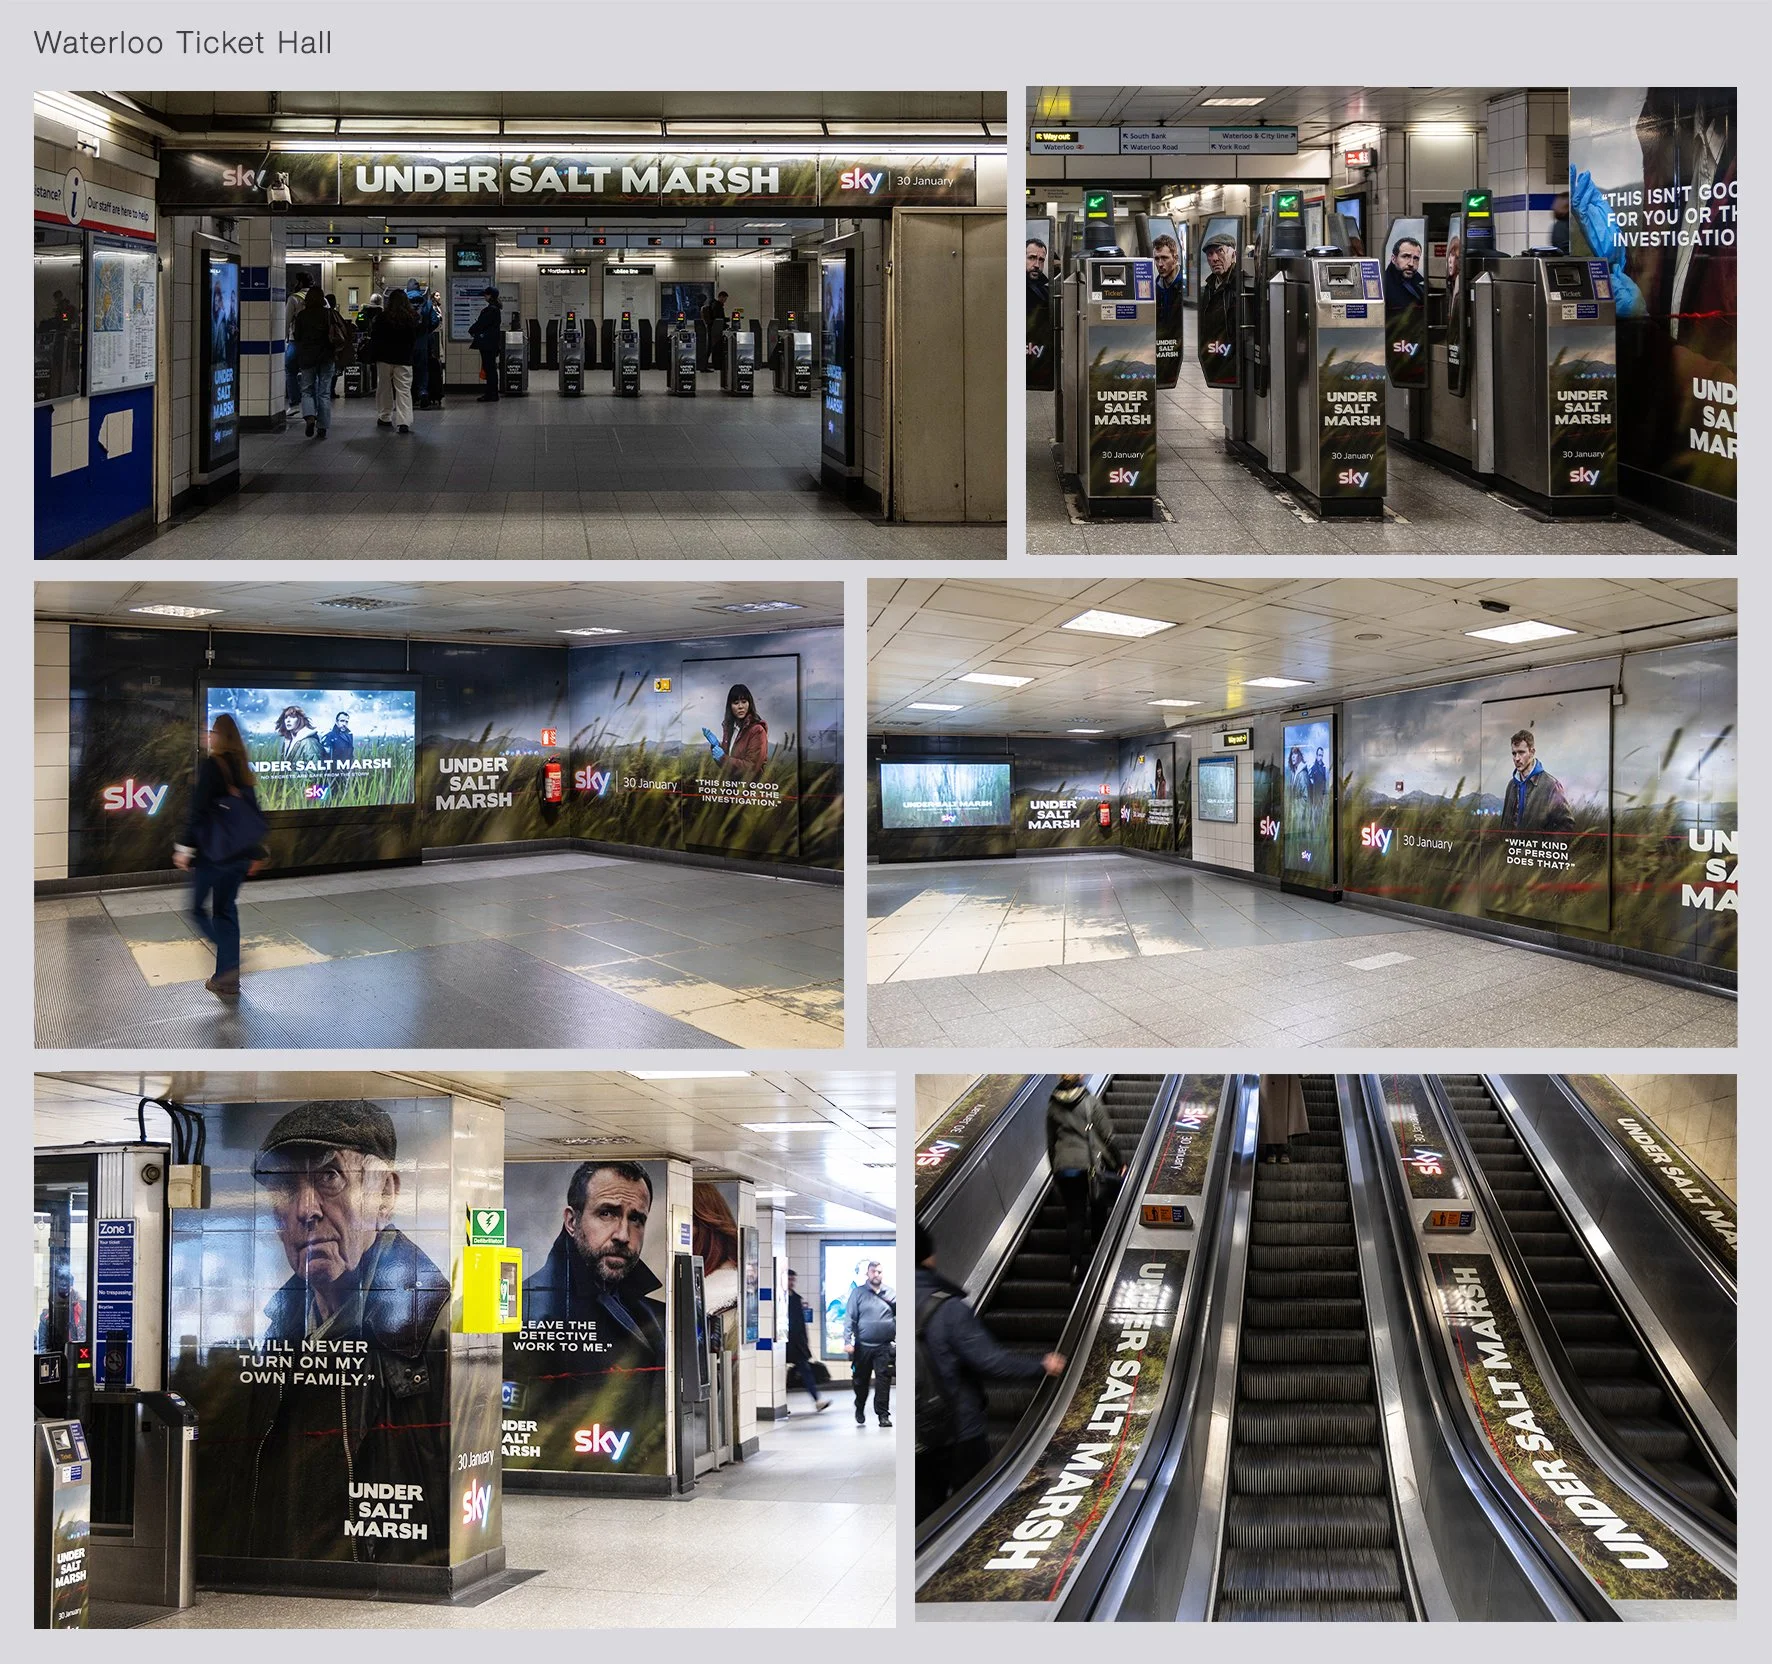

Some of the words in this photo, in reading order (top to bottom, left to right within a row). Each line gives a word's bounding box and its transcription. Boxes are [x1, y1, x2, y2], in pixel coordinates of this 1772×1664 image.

[1042, 133, 1058, 142] Way
[1057, 133, 1071, 141] out
[1129, 132, 1150, 140] South
[1151, 132, 1167, 140] Bank
[1221, 132, 1253, 140] Waterloo
[1260, 132, 1276, 141] City
[1276, 132, 1290, 140] line
[1043, 143, 1075, 151] Waterloo
[1130, 143, 1161, 151] Waterloo
[1162, 143, 1179, 151] Road
[1218, 143, 1234, 151] York
[1234, 143, 1251, 151] Road
[222, 164, 267, 192] sky
[355, 165, 500, 193] UNDER
[509, 165, 612, 193] SALT
[621, 166, 780, 194] MARSH
[840, 167, 883, 195] sky
[896, 176, 911, 186] 30
[912, 176, 954, 188] January
[1602, 191, 1643, 208] “THIS
[1647, 185, 1693, 204] ISN’T
[87, 196, 99, 210] Our
[99, 201, 112, 213] staff
[111, 205, 121, 215] are
[120, 205, 132, 218] here
[138, 210, 149, 224] help
[1607, 212, 1638, 228] FOR
[1642, 208, 1679, 227] YOU
[1685, 206, 1712, 224] OR
[1613, 228, 1735, 248] INVESTIGATIO
[1561, 290, 1582, 298] Ticket
[1158, 345, 1174, 353] SALT
[1207, 340, 1232, 357] sky
[1392, 339, 1419, 356] sky
[214, 367, 234, 385] UNDER
[216, 384, 231, 401] SALT
[1097, 390, 1149, 402] UNDER
[1326, 391, 1378, 403] UNDER
[1557, 390, 1609, 402] UNDER
[212, 400, 235, 420] MARSH
[1104, 402, 1142, 413] SALT
[1334, 403, 1371, 414] SALT
[1564, 402, 1602, 413] SALT
[1094, 414, 1152, 426] MARSH
[1324, 415, 1381, 426] MARSH
[1554, 413, 1612, 425] MARSH
[1101, 451, 1113, 459] 30
[1113, 451, 1145, 460] January
[1331, 452, 1342, 460] 30
[1343, 452, 1374, 461] January
[1562, 450, 1573, 459] 30
[1574, 450, 1605, 459] January
[1109, 467, 1140, 487] sky
[1338, 468, 1370, 488] sky
[1569, 466, 1600, 486] sky
[295, 760, 334, 772] SALT
[336, 758, 392, 771] MARSH
[439, 757, 508, 774] UNDER
[449, 774, 500, 792] SALT
[574, 765, 611, 796] sky
[623, 776, 636, 788] 30
[637, 777, 678, 793] January
[749, 781, 779, 791] GOOD
[103, 778, 169, 816] sky
[305, 784, 329, 800] sky
[698, 786, 718, 795] FOR
[719, 788, 740, 797] YOU
[742, 789, 757, 798] OR
[759, 790, 780, 799] THE
[435, 792, 513, 811] MARSH
[902, 801, 936, 809] UNDER
[959, 800, 993, 808] MARSH
[1030, 800, 1078, 810] UNDER
[941, 813, 957, 823] sky
[1037, 810, 1072, 820] SALT
[1120, 802, 1131, 823] sky
[1028, 819, 1081, 830] MARSH
[1259, 815, 1281, 841] sky
[1361, 821, 1393, 854] sky
[1403, 834, 1415, 847] 30
[1416, 835, 1454, 853] January
[1504, 838, 1539, 849] “WHAT
[1541, 841, 1568, 851] KIND
[1301, 850, 1312, 862] sky
[1506, 856, 1534, 867] DOES
[1508, 847, 1522, 856] OF
[1524, 848, 1569, 861] PERSON
[1174, 1107, 1209, 1130] sky
[1409, 1112, 1424, 1134] January
[916, 1139, 960, 1166] sky
[950, 1124, 966, 1134] 30
[959, 1103, 986, 1125] January
[1181, 1135, 1193, 1145] 30
[1413, 1133, 1426, 1143] 30
[1170, 1143, 1190, 1171] January
[1411, 1149, 1443, 1175] sky
[1617, 1117, 1673, 1165] UNDER
[1659, 1166, 1716, 1208] SALT
[100, 1223, 126, 1235] Zone
[127, 1223, 132, 1234] 1
[1115, 1262, 1167, 1353] UNDER
[568, 1321, 597, 1330] THE
[1452, 1267, 1513, 1370] MARSH
[519, 1331, 597, 1341] DETECTIVE
[248, 1339, 294, 1352] WILL
[301, 1340, 369, 1354] NEVER
[513, 1342, 556, 1352] WORK
[560, 1342, 578, 1352] TO
[582, 1343, 613, 1353] ME.”
[239, 1355, 292, 1368] TURN
[300, 1356, 328, 1369] ON
[335, 1357, 365, 1370] MY
[239, 1371, 286, 1385] OWN
[293, 1373, 376, 1387] FAMILY.”
[1086, 1360, 1141, 1437] SALT
[1488, 1375, 1555, 1452] SALT
[574, 1423, 631, 1462] sky
[457, 1454, 468, 1471] 30
[468, 1449, 495, 1468] January
[348, 1481, 424, 1501] UNDER
[358, 1502, 413, 1520] SALT
[462, 1478, 492, 1528] sky
[983, 1442, 1115, 1570] MARSH
[1532, 1458, 1669, 1570] UNDER
[344, 1520, 428, 1541] MARSH
[56, 1547, 86, 1565] UNDER
[60, 1560, 82, 1575] SALT
[55, 1569, 87, 1589] MARSH
[58, 1611, 65, 1621] 30
[65, 1607, 83, 1619] January
